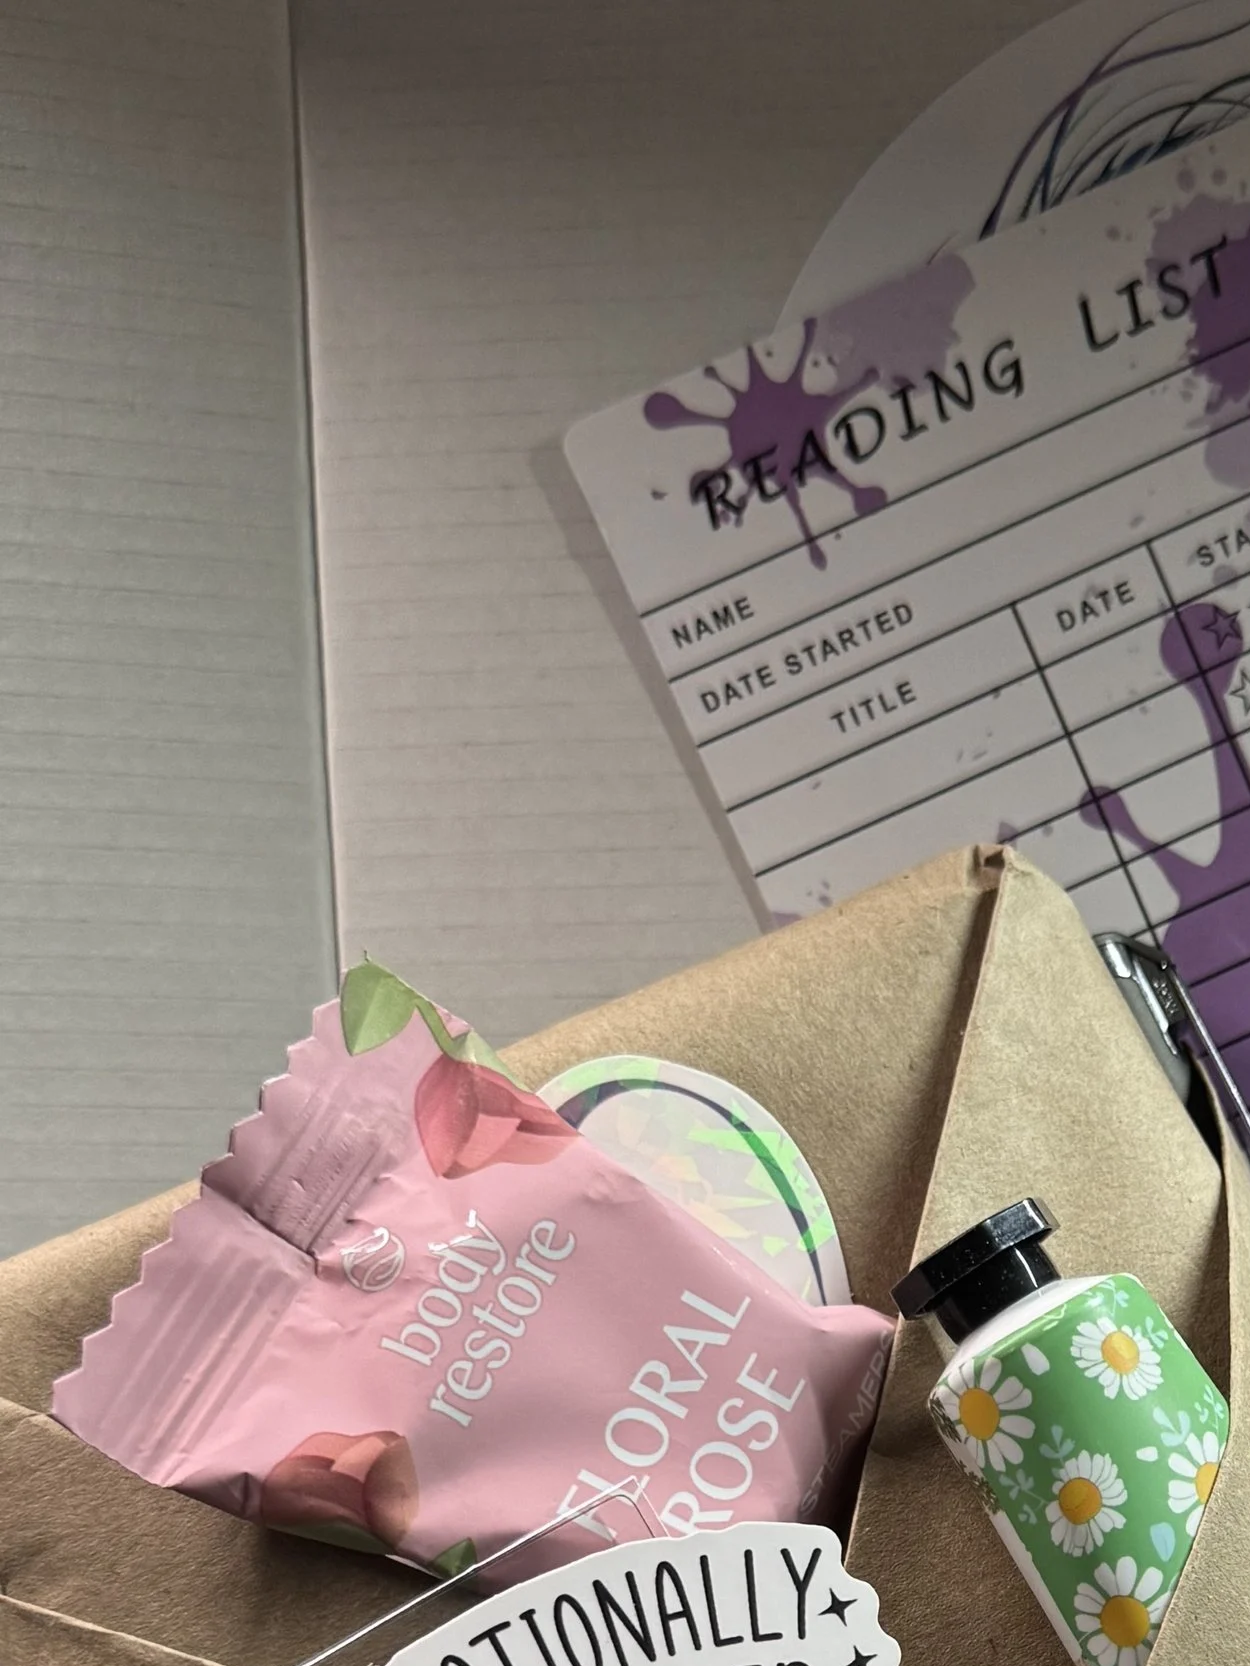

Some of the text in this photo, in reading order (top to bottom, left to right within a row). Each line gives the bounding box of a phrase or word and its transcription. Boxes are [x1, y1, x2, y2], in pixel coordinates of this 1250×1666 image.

[696, 236, 1228, 531] READING LIST
[671, 597, 756, 649] NAME
[700, 603, 916, 715] DATE STARTED
[1056, 581, 1136, 633] DATE
[829, 681, 918, 734] TITLE
[380, 1208, 508, 1366] body
[428, 1219, 577, 1428] restore
[555, 1289, 752, 1542] FLORAL
[660, 1351, 806, 1536] ROSE
